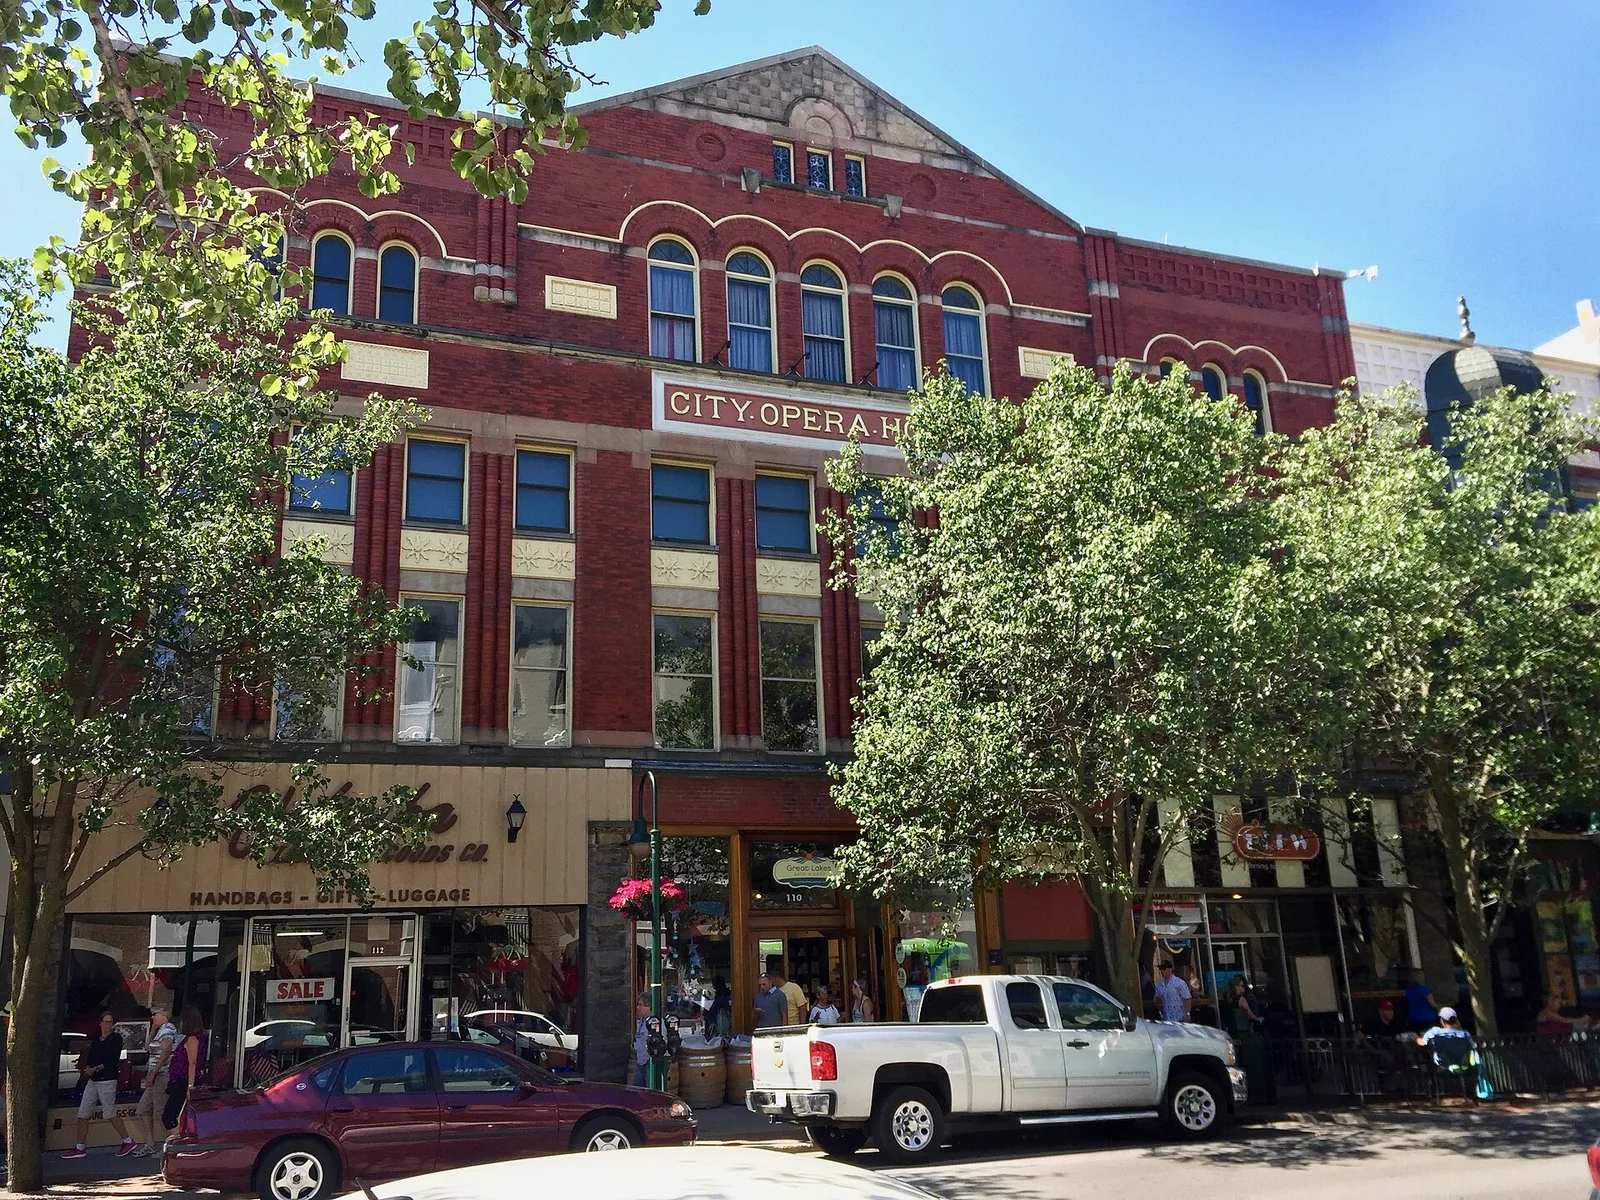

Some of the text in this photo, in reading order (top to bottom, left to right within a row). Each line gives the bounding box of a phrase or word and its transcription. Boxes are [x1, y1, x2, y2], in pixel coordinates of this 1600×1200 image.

[670, 391, 752, 421] CITY
[759, 402, 870, 436] OPERA
[459, 843, 490, 863] CO.
[189, 889, 471, 906] HANDBAGS GIFT LUGGAGE
[786, 894, 803, 902] 110
[277, 981, 325, 999] SALE
